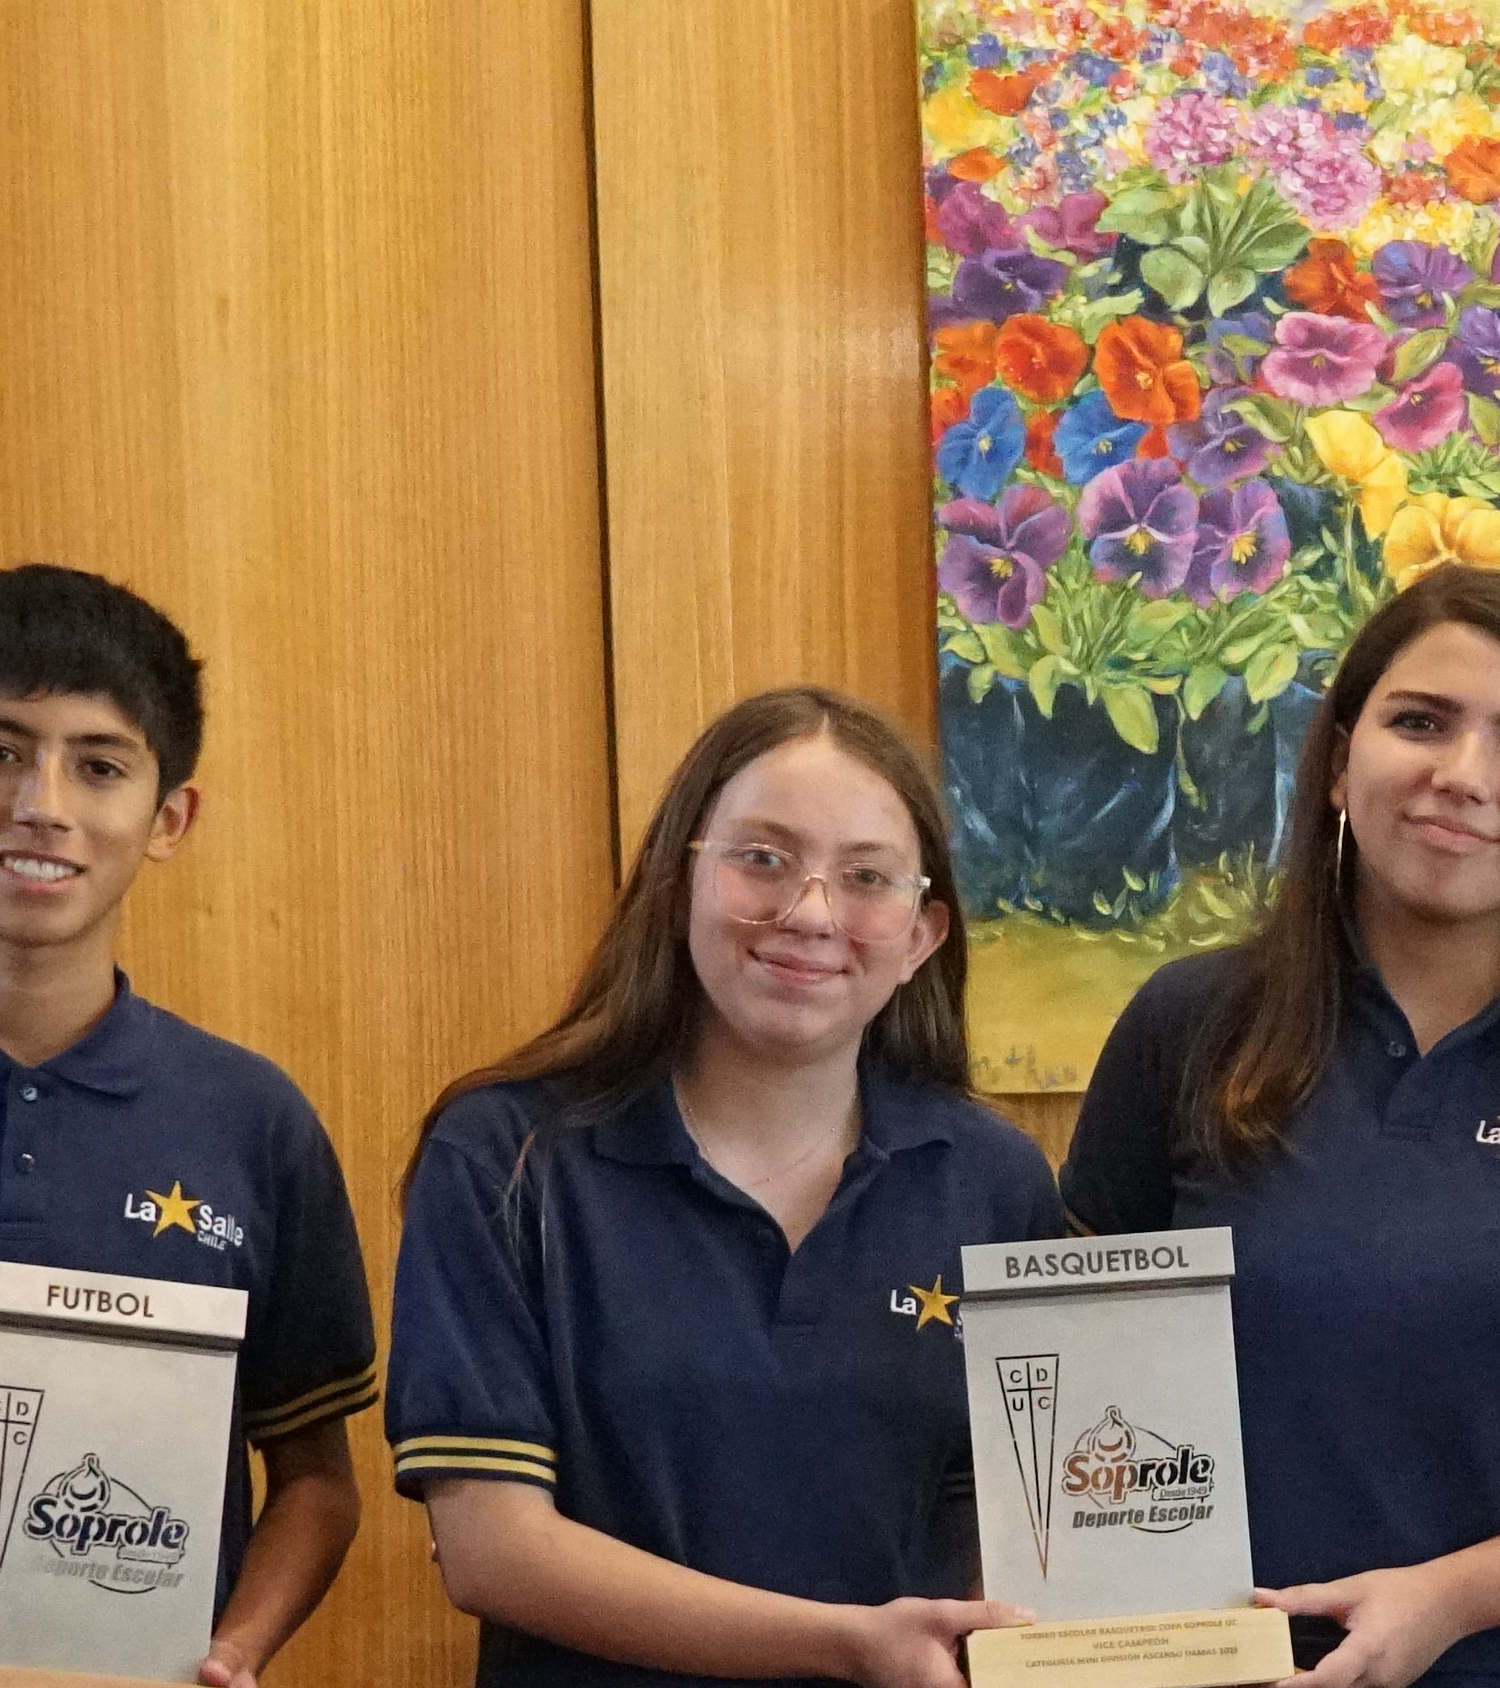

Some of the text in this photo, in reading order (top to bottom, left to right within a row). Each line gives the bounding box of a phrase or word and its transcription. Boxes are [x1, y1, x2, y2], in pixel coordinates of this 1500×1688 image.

[124, 1193, 244, 1247] La Salle
[196, 1230, 228, 1251] CHILE
[1005, 1245, 1190, 1279] BASQUETBOL
[47, 1284, 154, 1318] FUTBOL
[890, 1289, 917, 1316] La
[1010, 1367, 1048, 1384] C D
[16, 1401, 29, 1416] D
[1012, 1396, 1051, 1412] U C
[13, 1430, 27, 1446] C
[1065, 1449, 1211, 1501] Soprole
[27, 1499, 185, 1552] Soprole
[1072, 1503, 1215, 1529] Deporte Escolar
